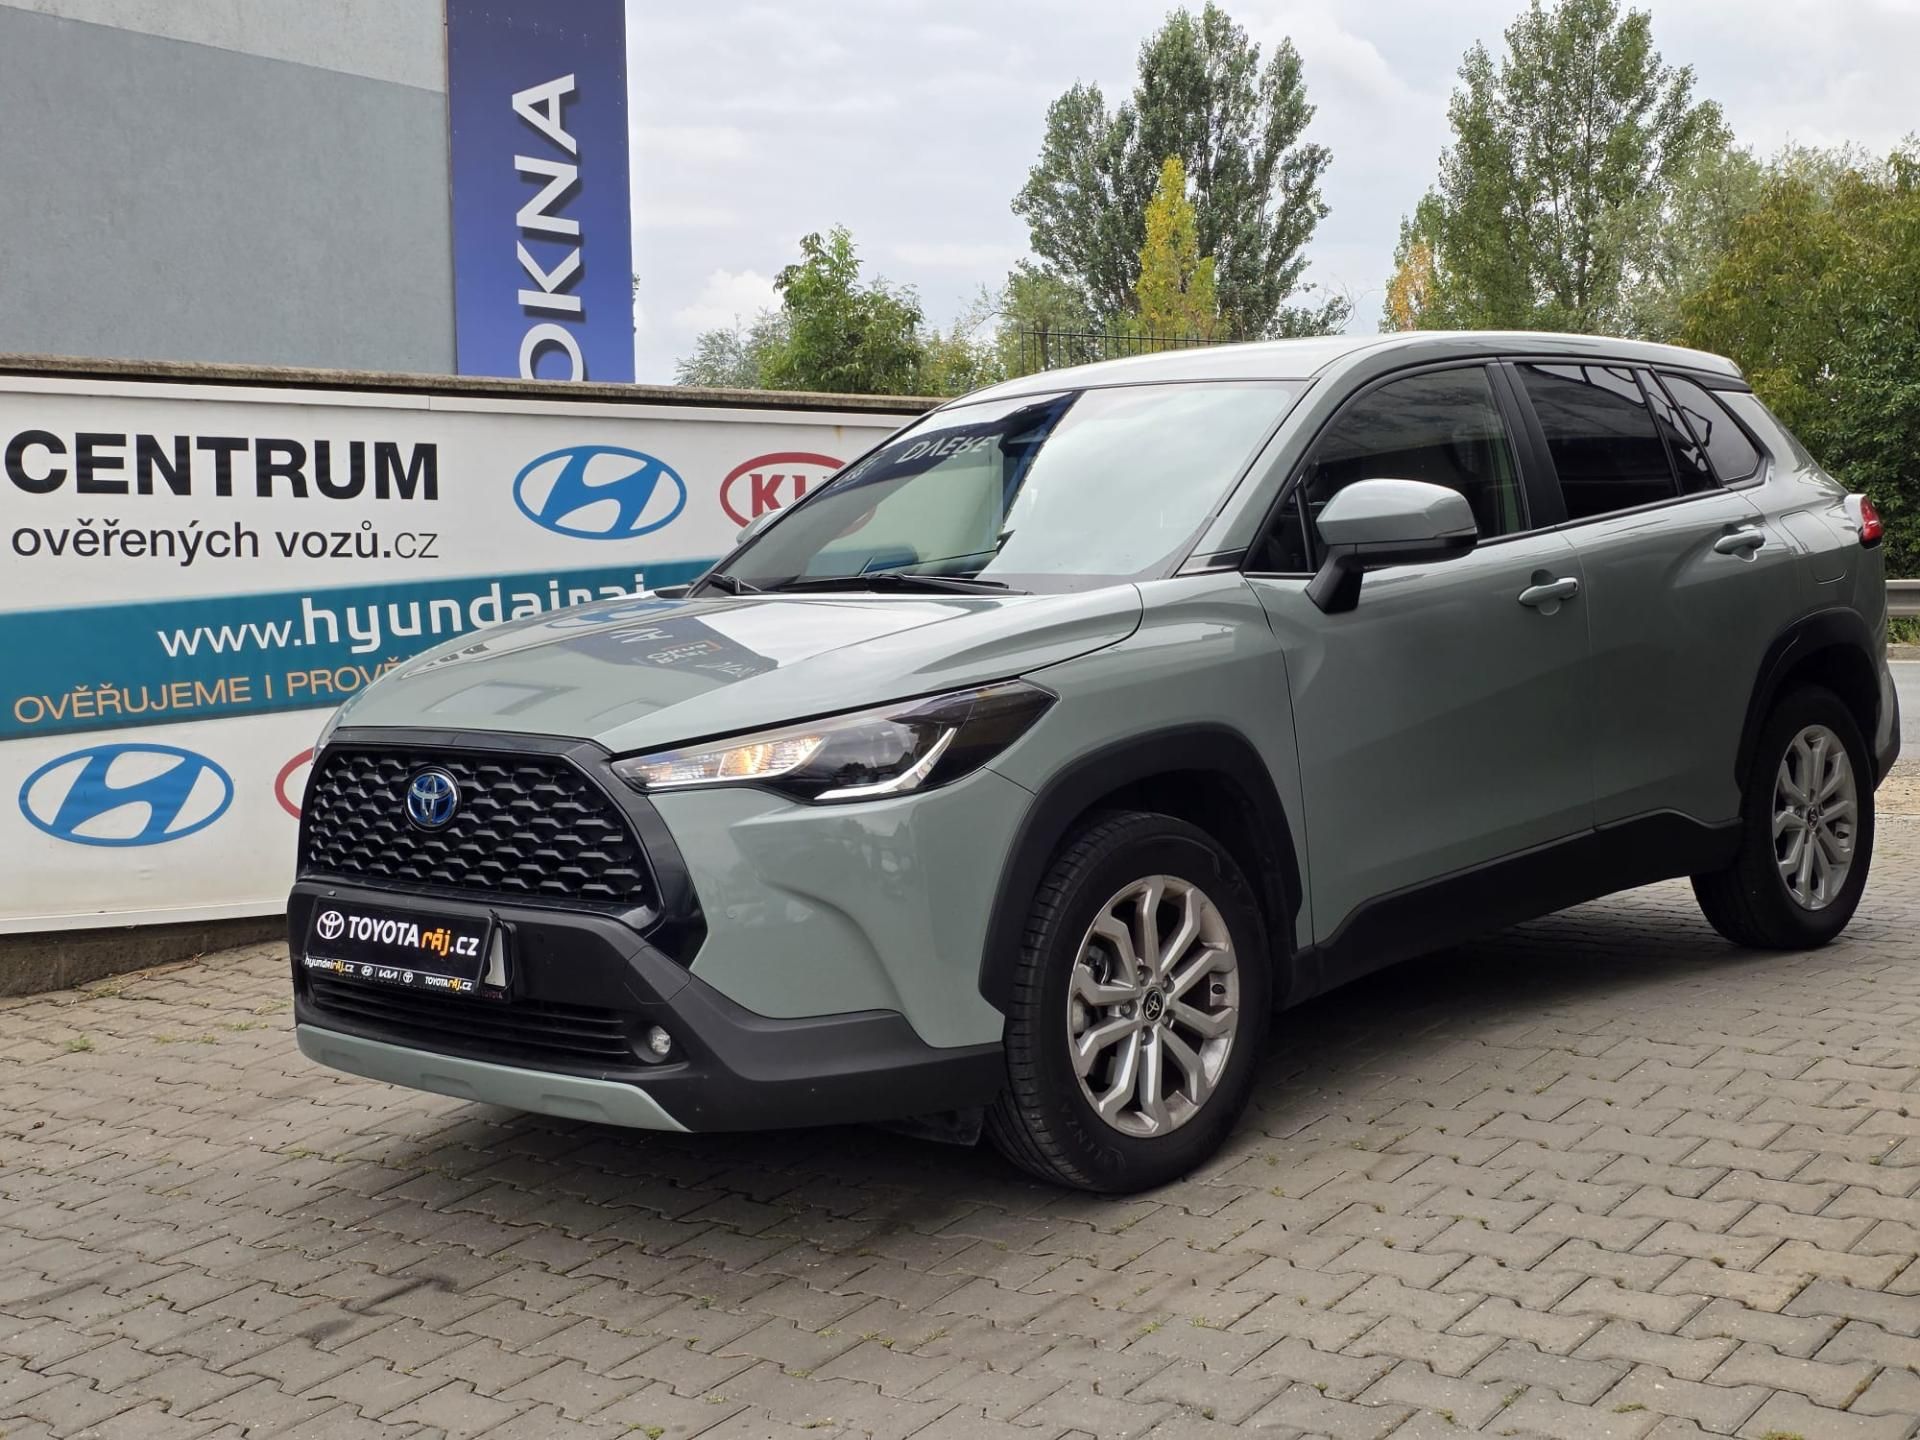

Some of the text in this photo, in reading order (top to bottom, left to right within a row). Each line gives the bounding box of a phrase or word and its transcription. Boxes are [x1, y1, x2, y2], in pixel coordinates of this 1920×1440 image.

[512, 73, 585, 382] OKNA
[4, 429, 439, 500] CENTRUM
[749, 473, 828, 518] KI
[11, 518, 439, 567] ověřených vozů.cz
[14, 675, 252, 725] OVĚŘUJEME
[265, 674, 273, 699] I
